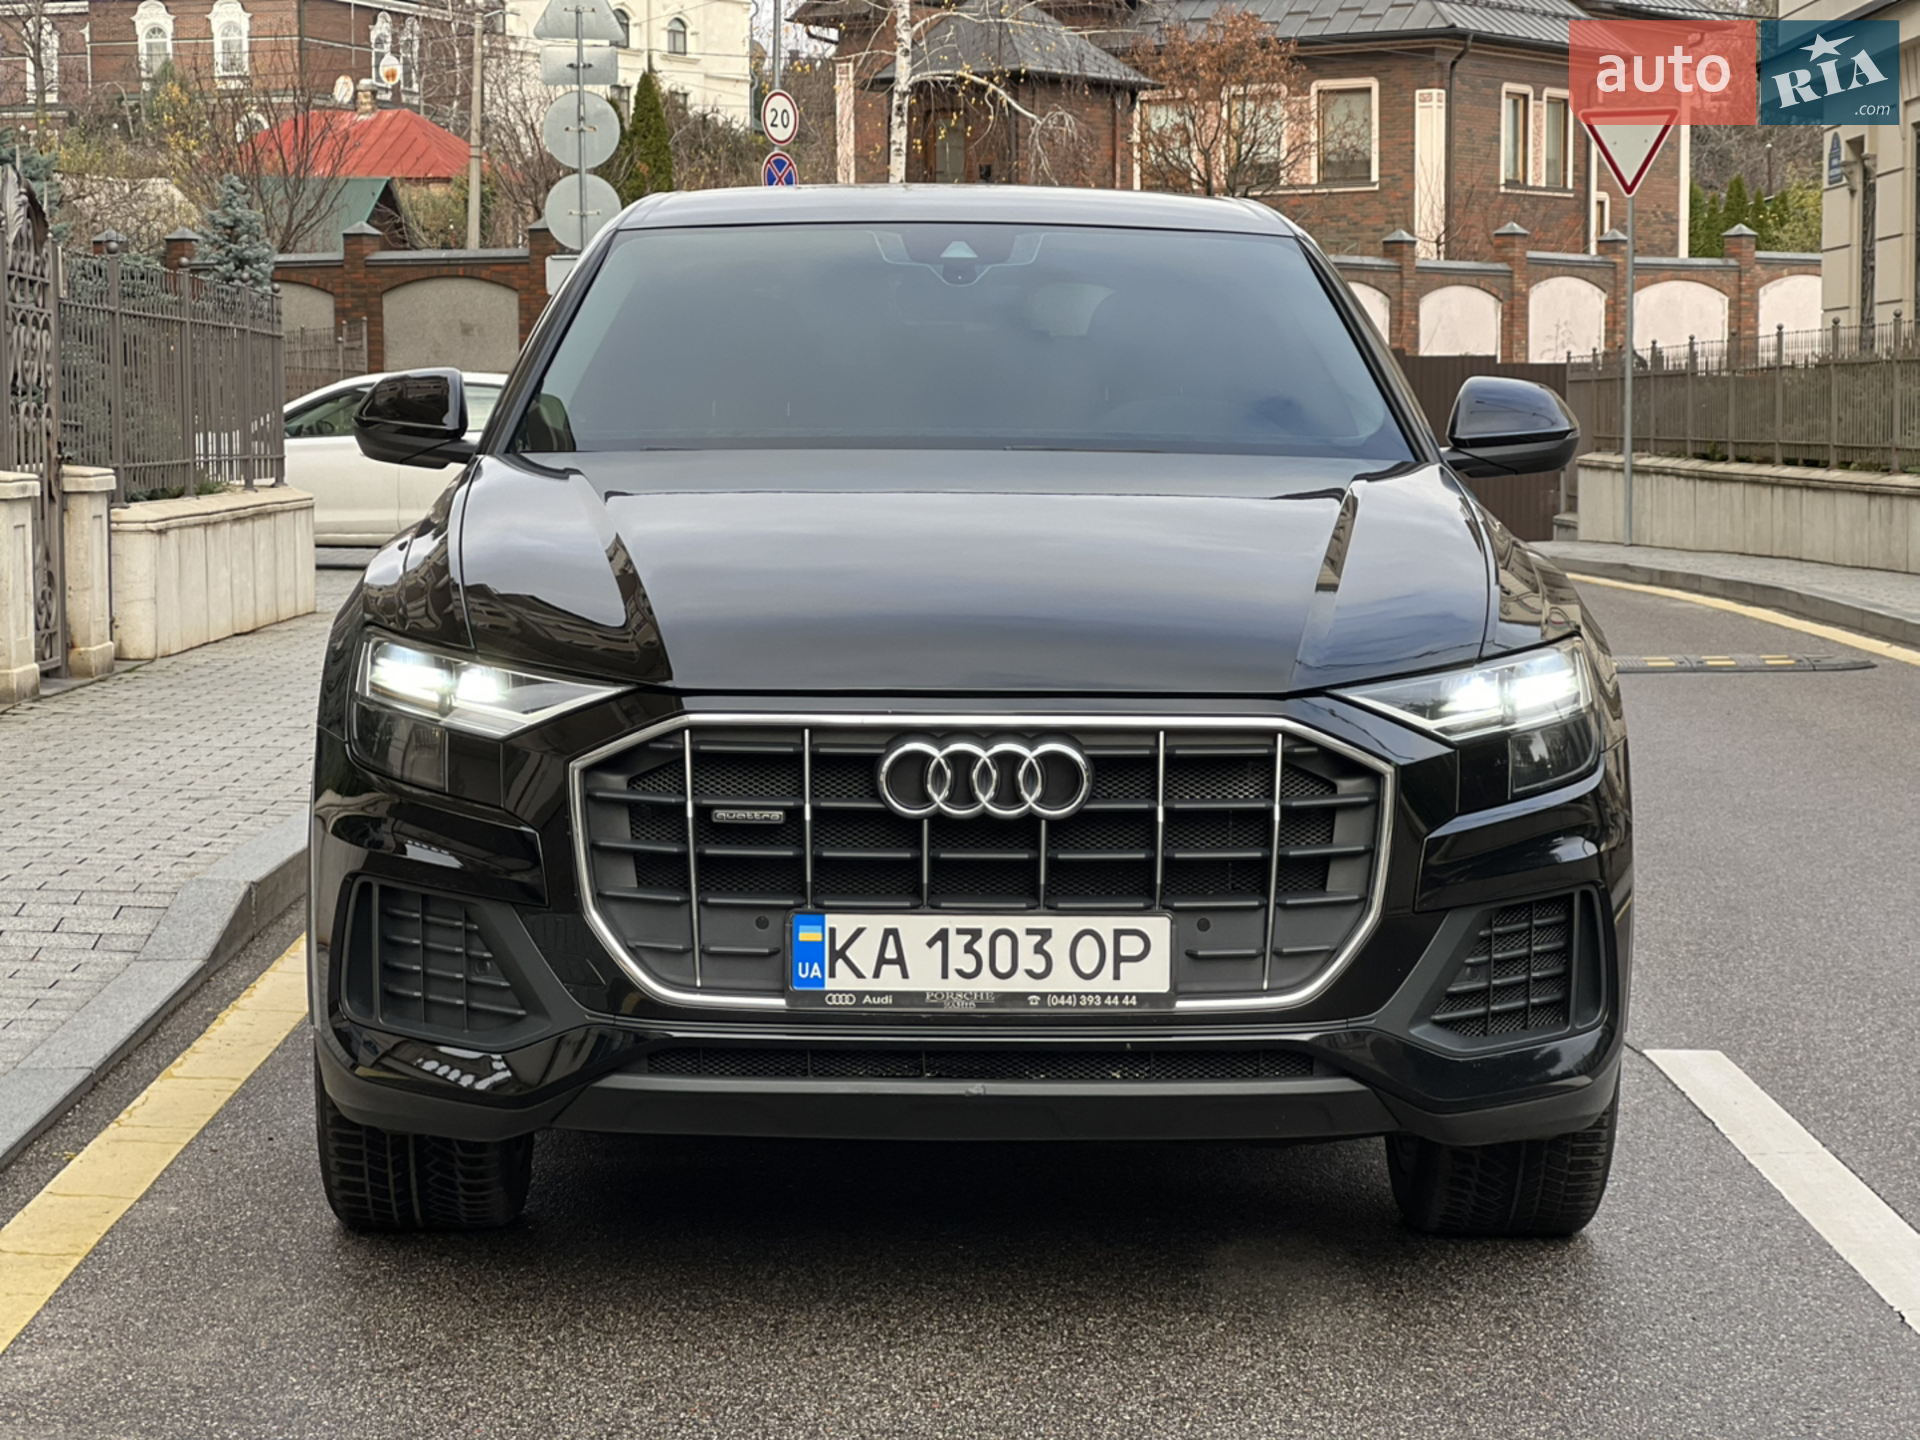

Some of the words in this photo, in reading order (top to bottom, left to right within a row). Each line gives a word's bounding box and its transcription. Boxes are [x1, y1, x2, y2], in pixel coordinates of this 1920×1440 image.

[770, 107, 790, 129] 20
[716, 811, 780, 821] quattro
[828, 926, 910, 979] KA
[925, 927, 1053, 980] 1303
[1069, 928, 1151, 981] OP
[798, 962, 822, 979] UA
[862, 994, 893, 1005] Audi
[925, 991, 995, 1001] PORSCHE
[1047, 994, 1077, 1007] (044)
[1080, 995, 1101, 1006] 393
[1104, 995, 1119, 1006] 44
[1122, 995, 1137, 1006] 44
